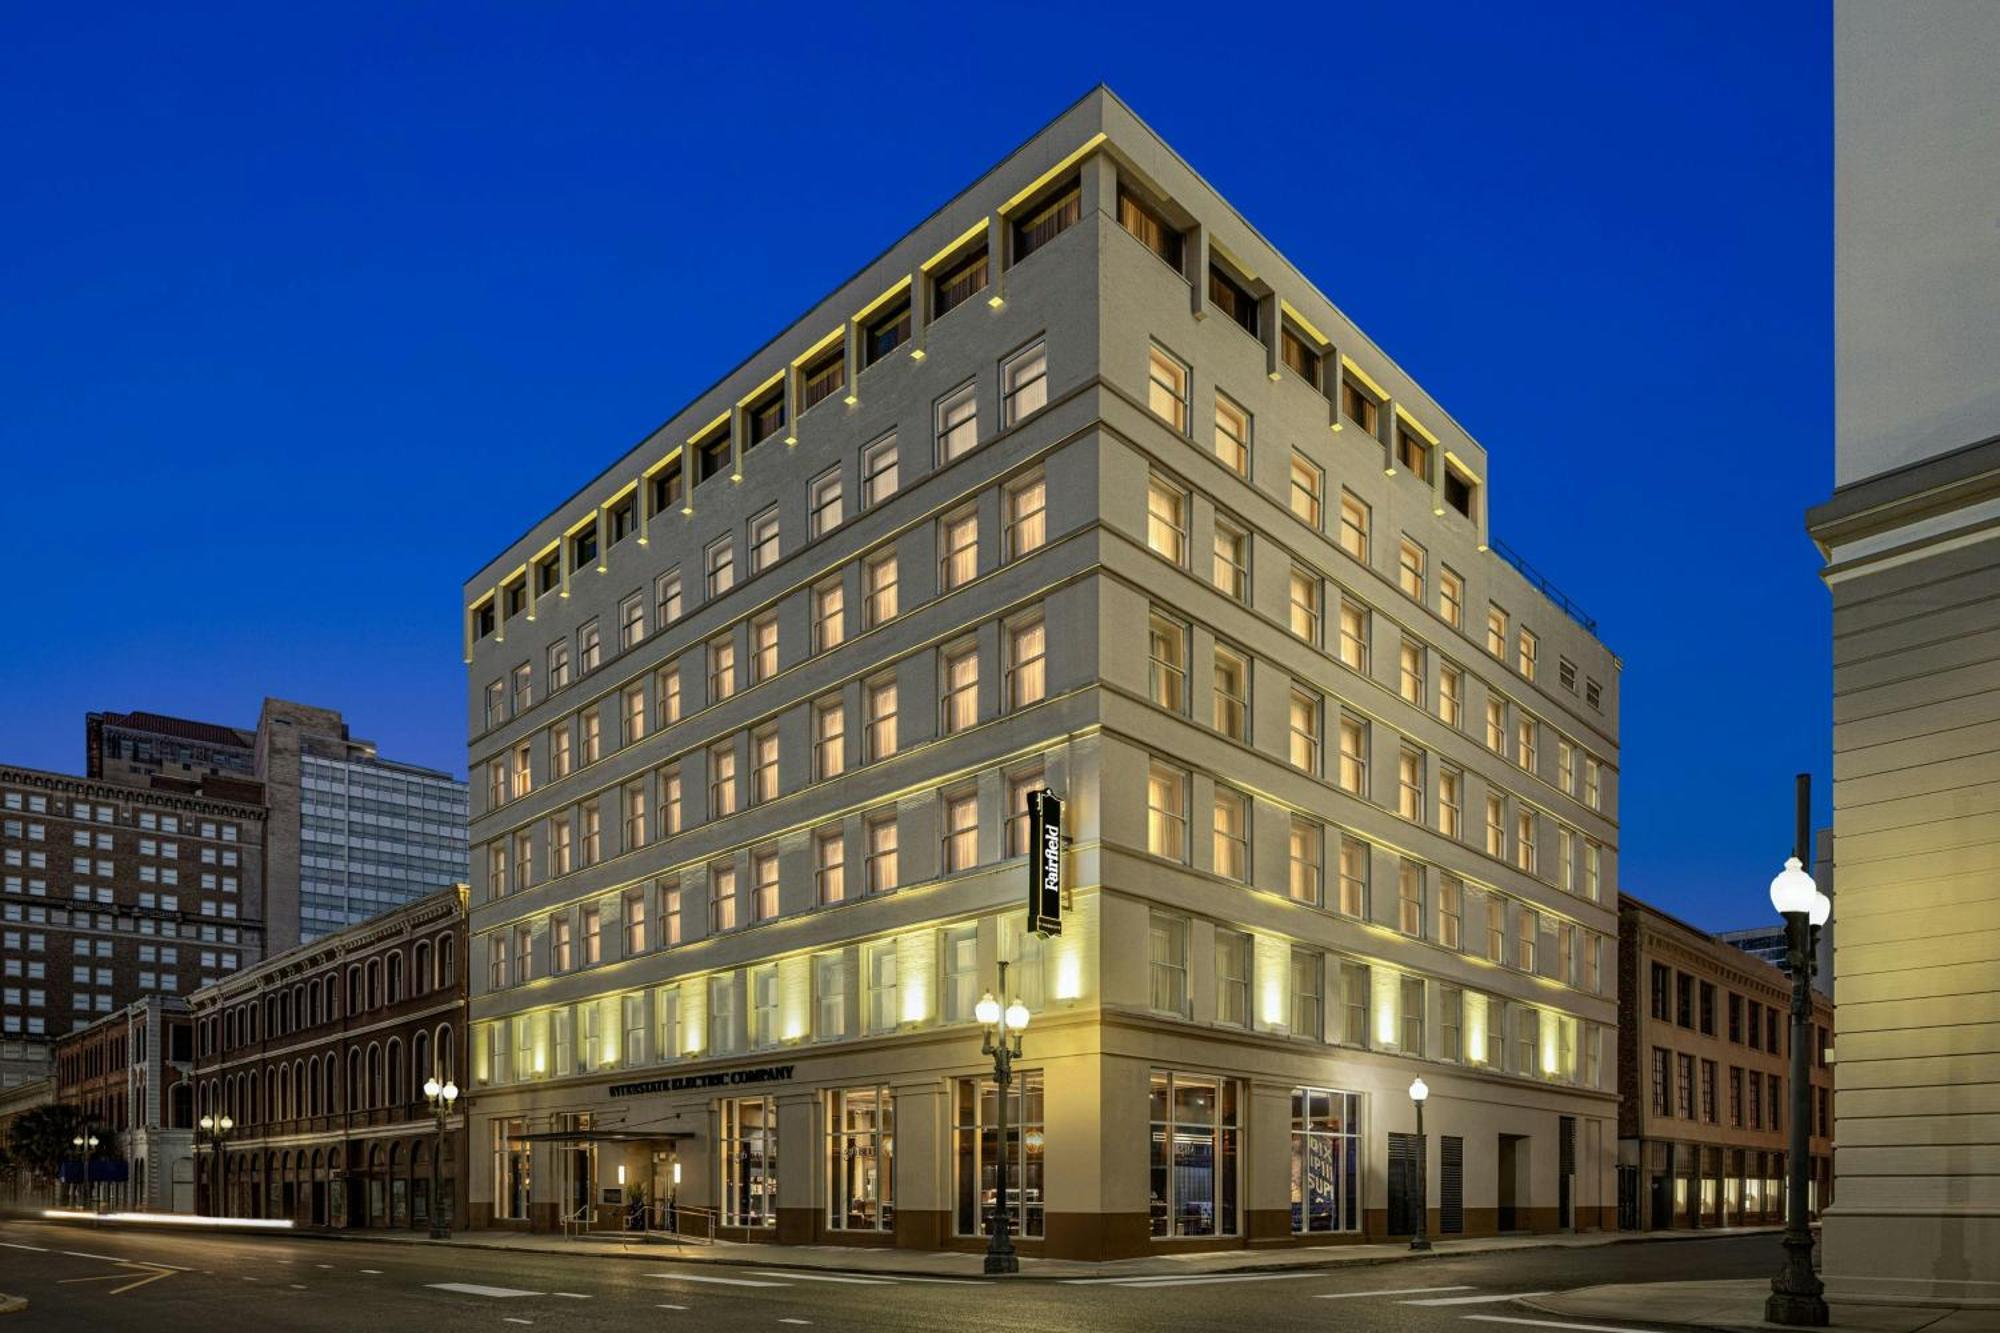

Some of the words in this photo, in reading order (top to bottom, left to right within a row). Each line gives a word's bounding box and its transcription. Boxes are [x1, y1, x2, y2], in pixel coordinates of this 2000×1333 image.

[1044, 824, 1059, 892] Fairfield
[671, 1073, 729, 1091] ELECTRIC
[730, 1065, 794, 1084] COMPANY
